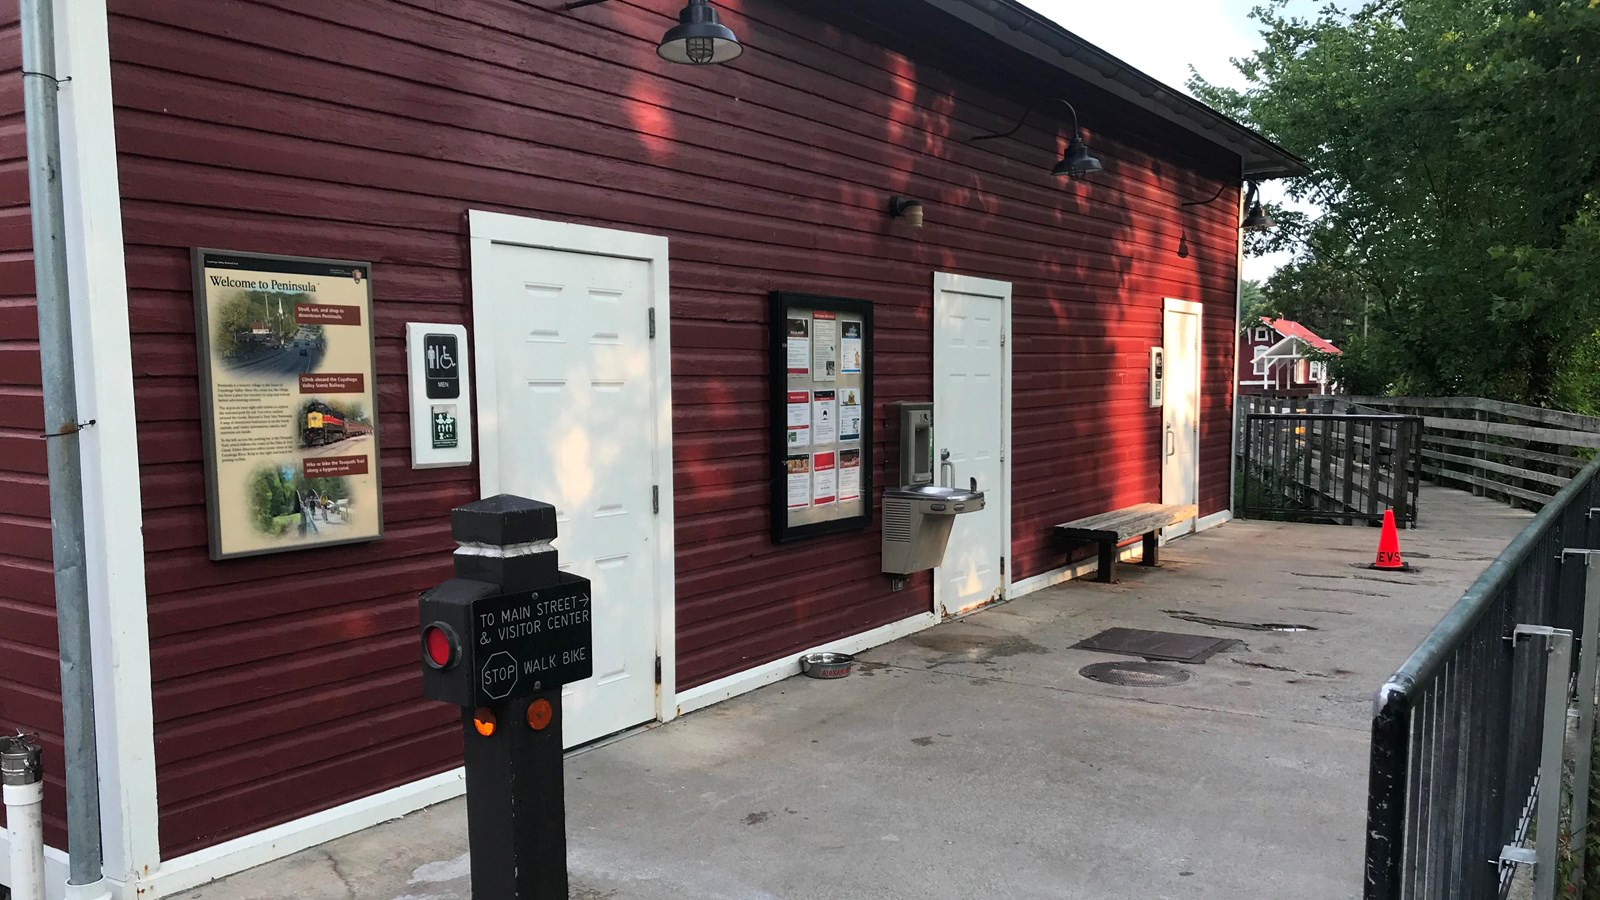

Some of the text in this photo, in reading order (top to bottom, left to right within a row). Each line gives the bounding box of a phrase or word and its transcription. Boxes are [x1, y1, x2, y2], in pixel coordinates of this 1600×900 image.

[210, 275, 316, 292] Welcome to Peninsula
[480, 596, 577, 628] TO MAIN STREET
[480, 610, 589, 645] & VISITOR CENTER
[484, 647, 586, 684] STOP WALK BIKE
